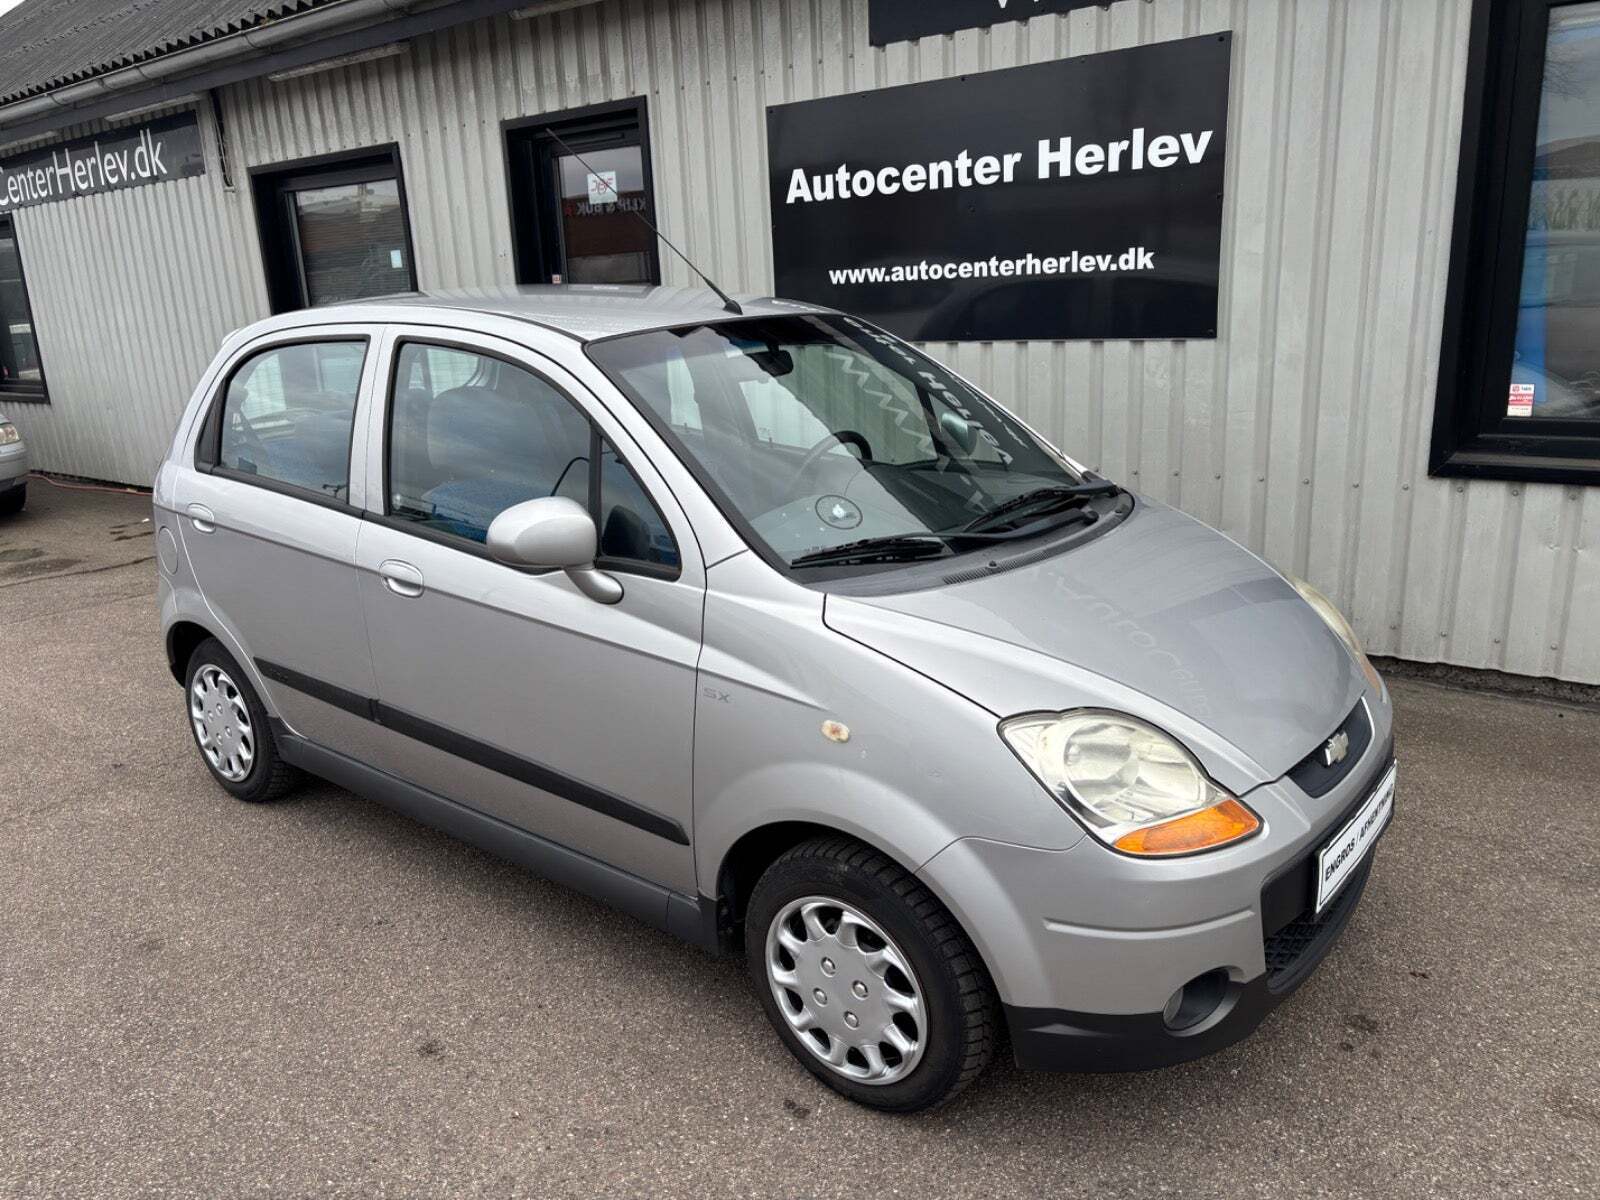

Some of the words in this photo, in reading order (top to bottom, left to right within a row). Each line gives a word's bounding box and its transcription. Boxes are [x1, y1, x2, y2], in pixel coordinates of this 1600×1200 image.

[785, 149, 1022, 204] Autocenter
[1037, 127, 1213, 180] Herlev
[828, 247, 1155, 285] www.autocenterherlev.dk
[703, 687, 730, 704] SX
[1325, 838, 1355, 882] ENGROS
